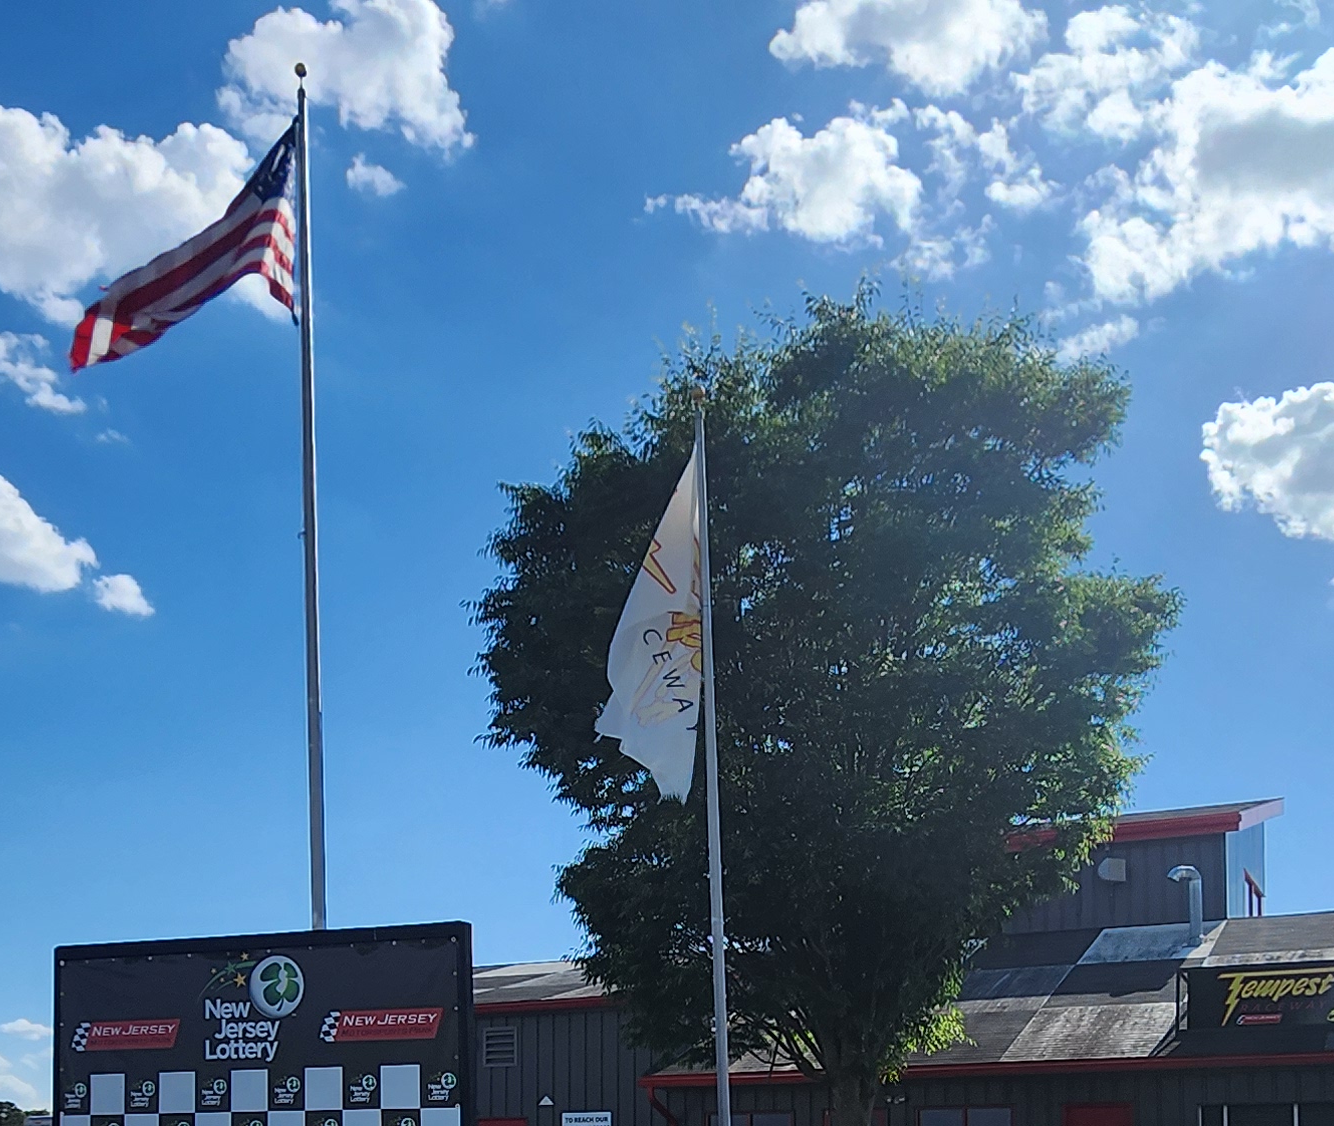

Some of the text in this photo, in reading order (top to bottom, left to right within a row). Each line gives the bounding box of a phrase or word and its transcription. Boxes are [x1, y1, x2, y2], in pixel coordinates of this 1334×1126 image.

[204, 998, 251, 1020] New
[1239, 1000, 1327, 1013] RACEWAY
[343, 1012, 438, 1027] NEW JERSEY
[91, 1023, 176, 1037] NEW JERSEY
[214, 1018, 281, 1041] Jersey
[204, 1039, 279, 1062] Lottery
